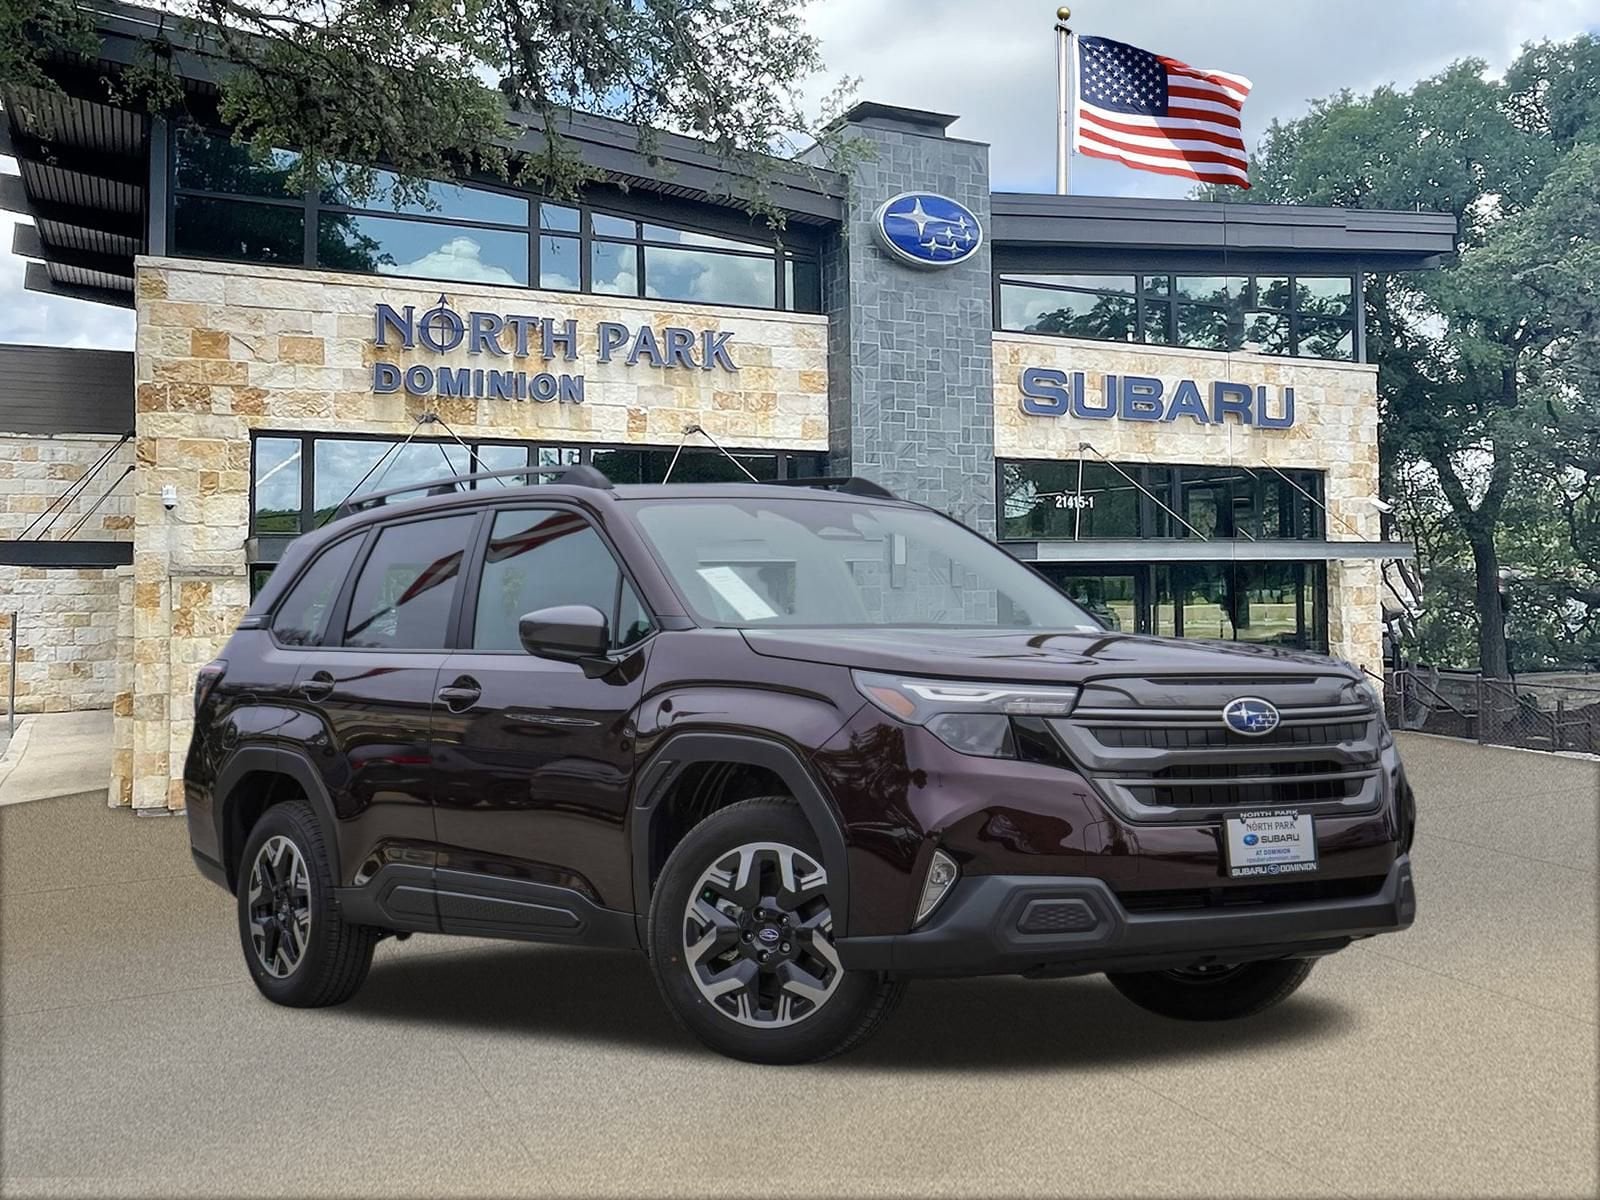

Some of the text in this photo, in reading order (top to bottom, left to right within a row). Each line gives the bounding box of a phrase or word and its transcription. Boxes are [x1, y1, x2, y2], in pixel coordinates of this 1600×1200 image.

[374, 293, 740, 372] NORTH PARK
[373, 362, 585, 403] DOMINION
[1019, 366, 1294, 430] SUBARU
[1274, 809, 1298, 817] PARK
[1246, 821, 1296, 832] NORTH PARK
[1261, 834, 1300, 844] SUBARU
[1264, 848, 1291, 856] DOMINION
[1232, 863, 1317, 877] SUBARU DOMINION
